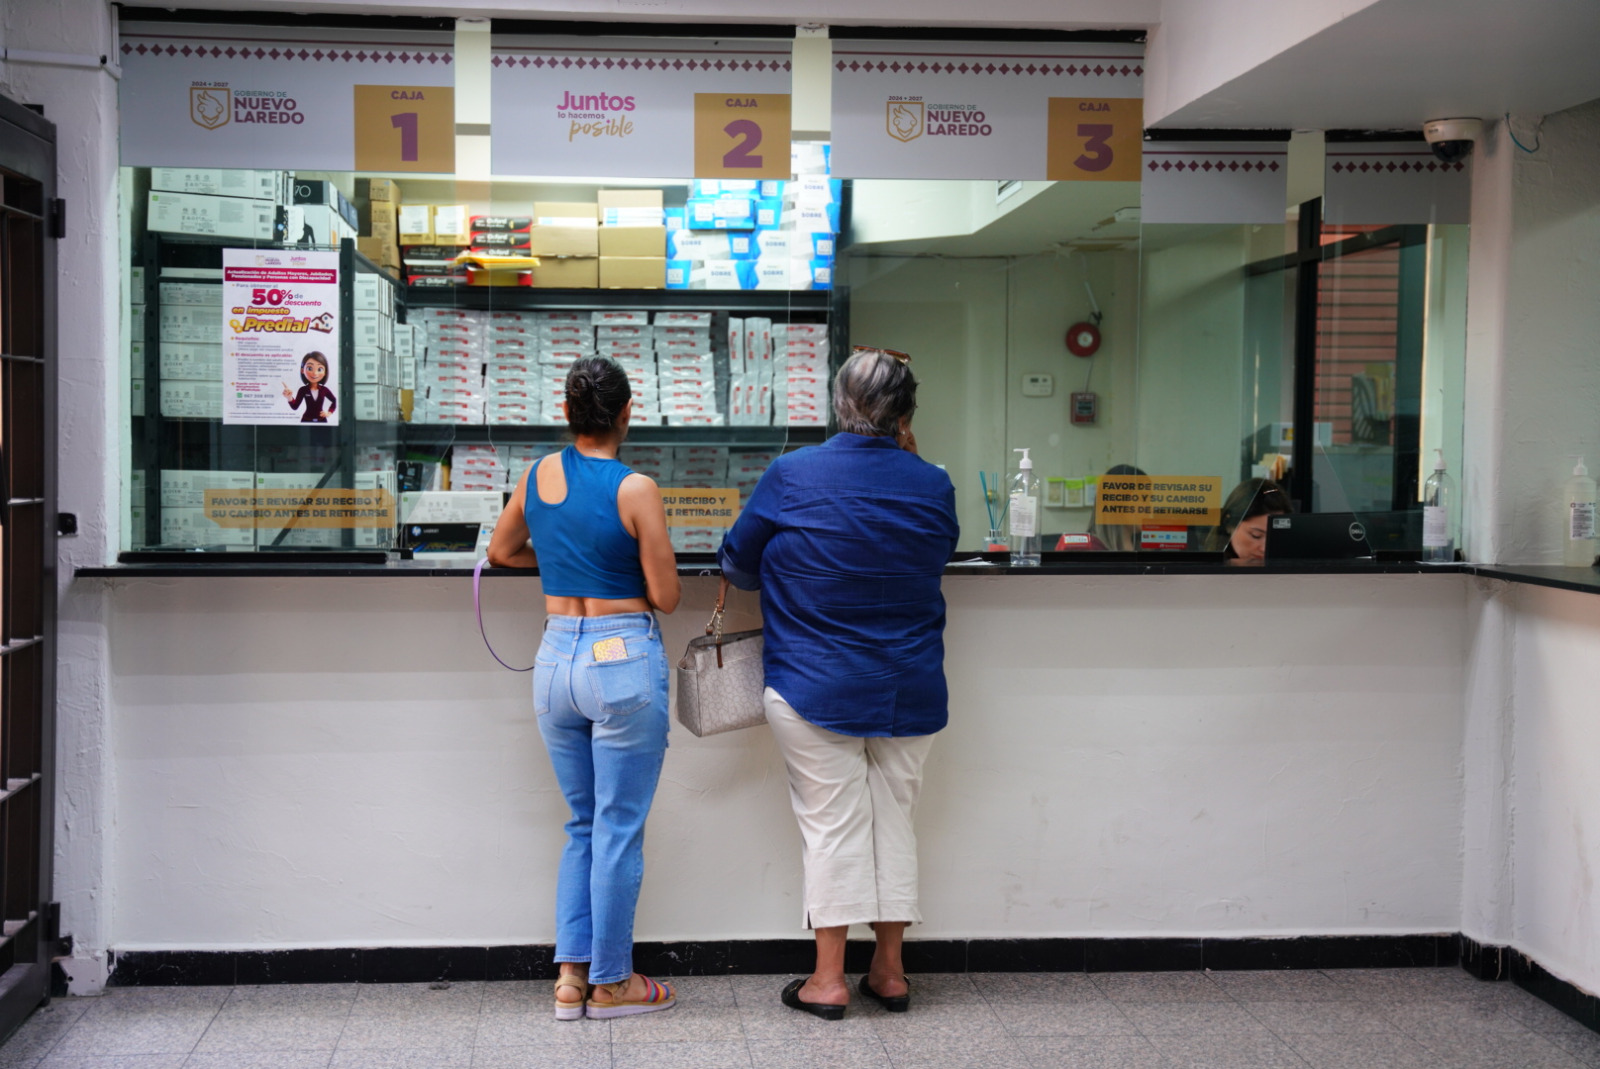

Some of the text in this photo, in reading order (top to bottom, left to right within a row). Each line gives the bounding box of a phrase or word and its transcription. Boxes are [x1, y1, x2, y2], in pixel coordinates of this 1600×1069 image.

[391, 90, 424, 100] CAJA
[557, 91, 635, 111] Juntos
[234, 98, 296, 110] NUEVO
[725, 98, 758, 108] CAJA
[1079, 102, 1110, 112] CAJA
[234, 111, 304, 124] LAREDO
[927, 111, 985, 123] NUEVO
[569, 115, 634, 142] posible
[927, 124, 992, 136] LAREDO
[391, 112, 418, 161] 1
[723, 119, 763, 168] 2
[1073, 124, 1114, 172] 3
[251, 289, 293, 306] 50%
[247, 306, 290, 315] impuesto
[243, 317, 311, 333] Predial
[1103, 482, 1136, 490] FAVOR
[1166, 495, 1205, 503] CAMBIO
[212, 509, 226, 518] SU
[230, 509, 272, 517] CAMBIO
[275, 509, 310, 517] ANTES
[330, 509, 388, 517] RETIRARSE
[1153, 506, 1208, 515] RETIRARSE
